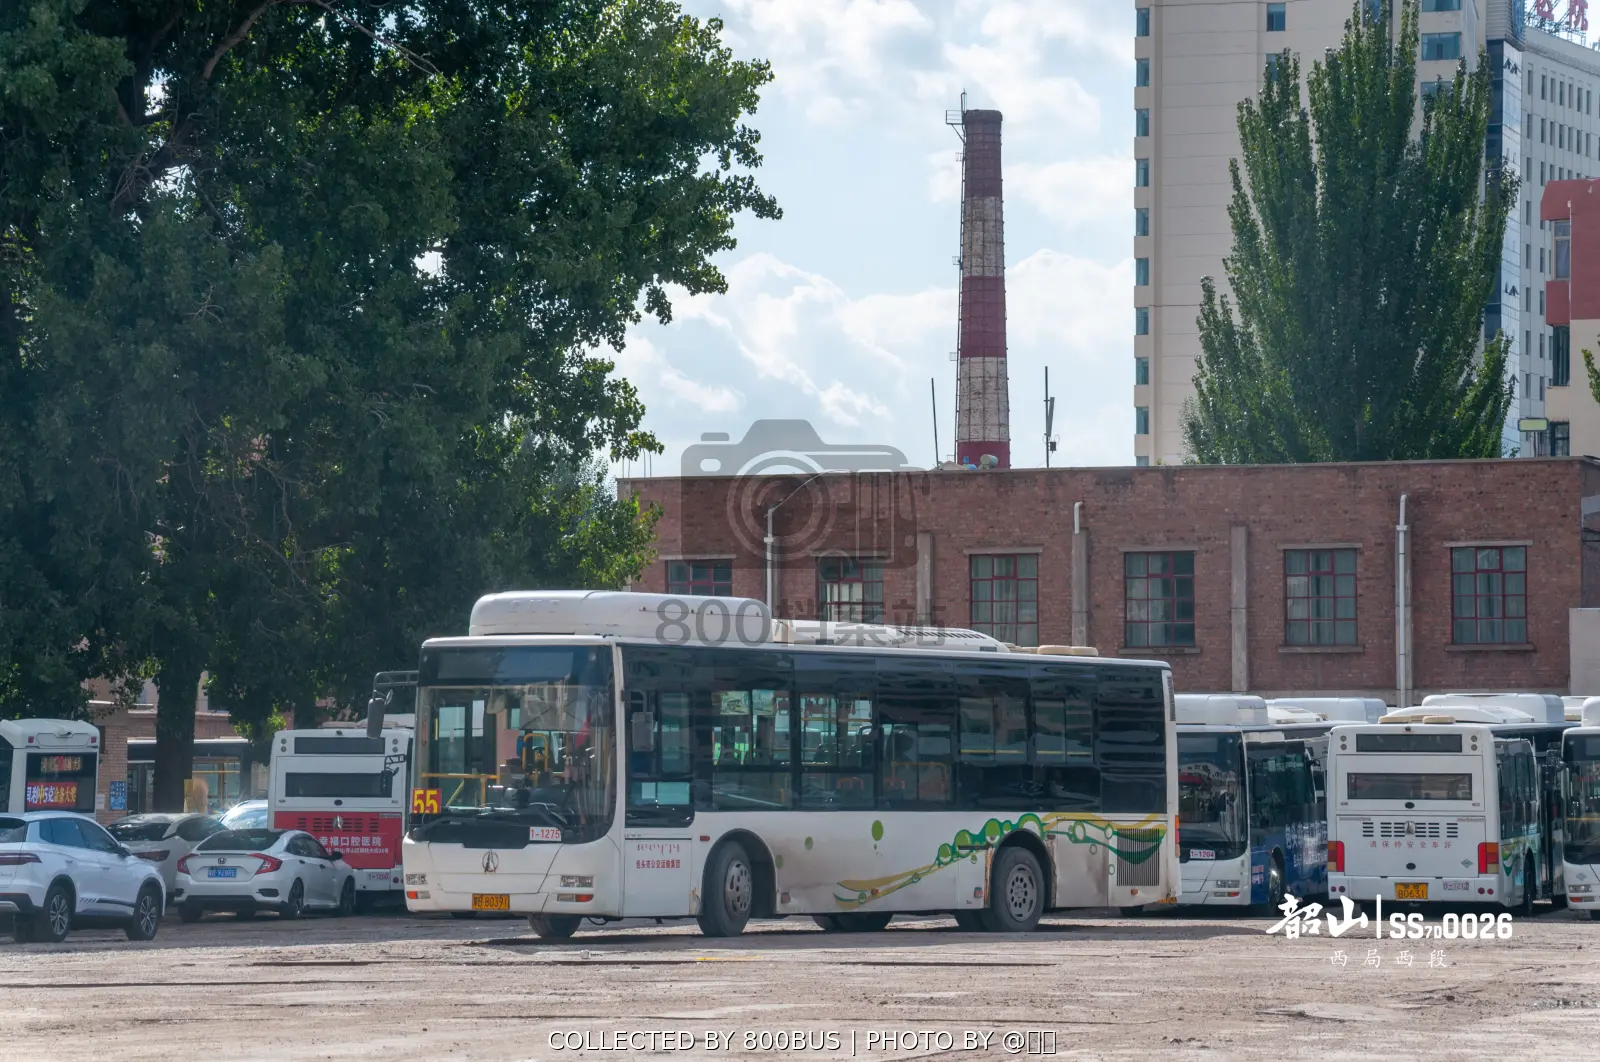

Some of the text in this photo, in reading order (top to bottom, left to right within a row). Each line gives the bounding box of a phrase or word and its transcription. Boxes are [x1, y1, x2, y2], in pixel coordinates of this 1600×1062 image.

[412, 788, 439, 814] 55
[530, 828, 561, 840] 1-1275
[635, 859, 681, 869] 包头市公交运输集团
[1397, 889, 1426, 900] 80631
